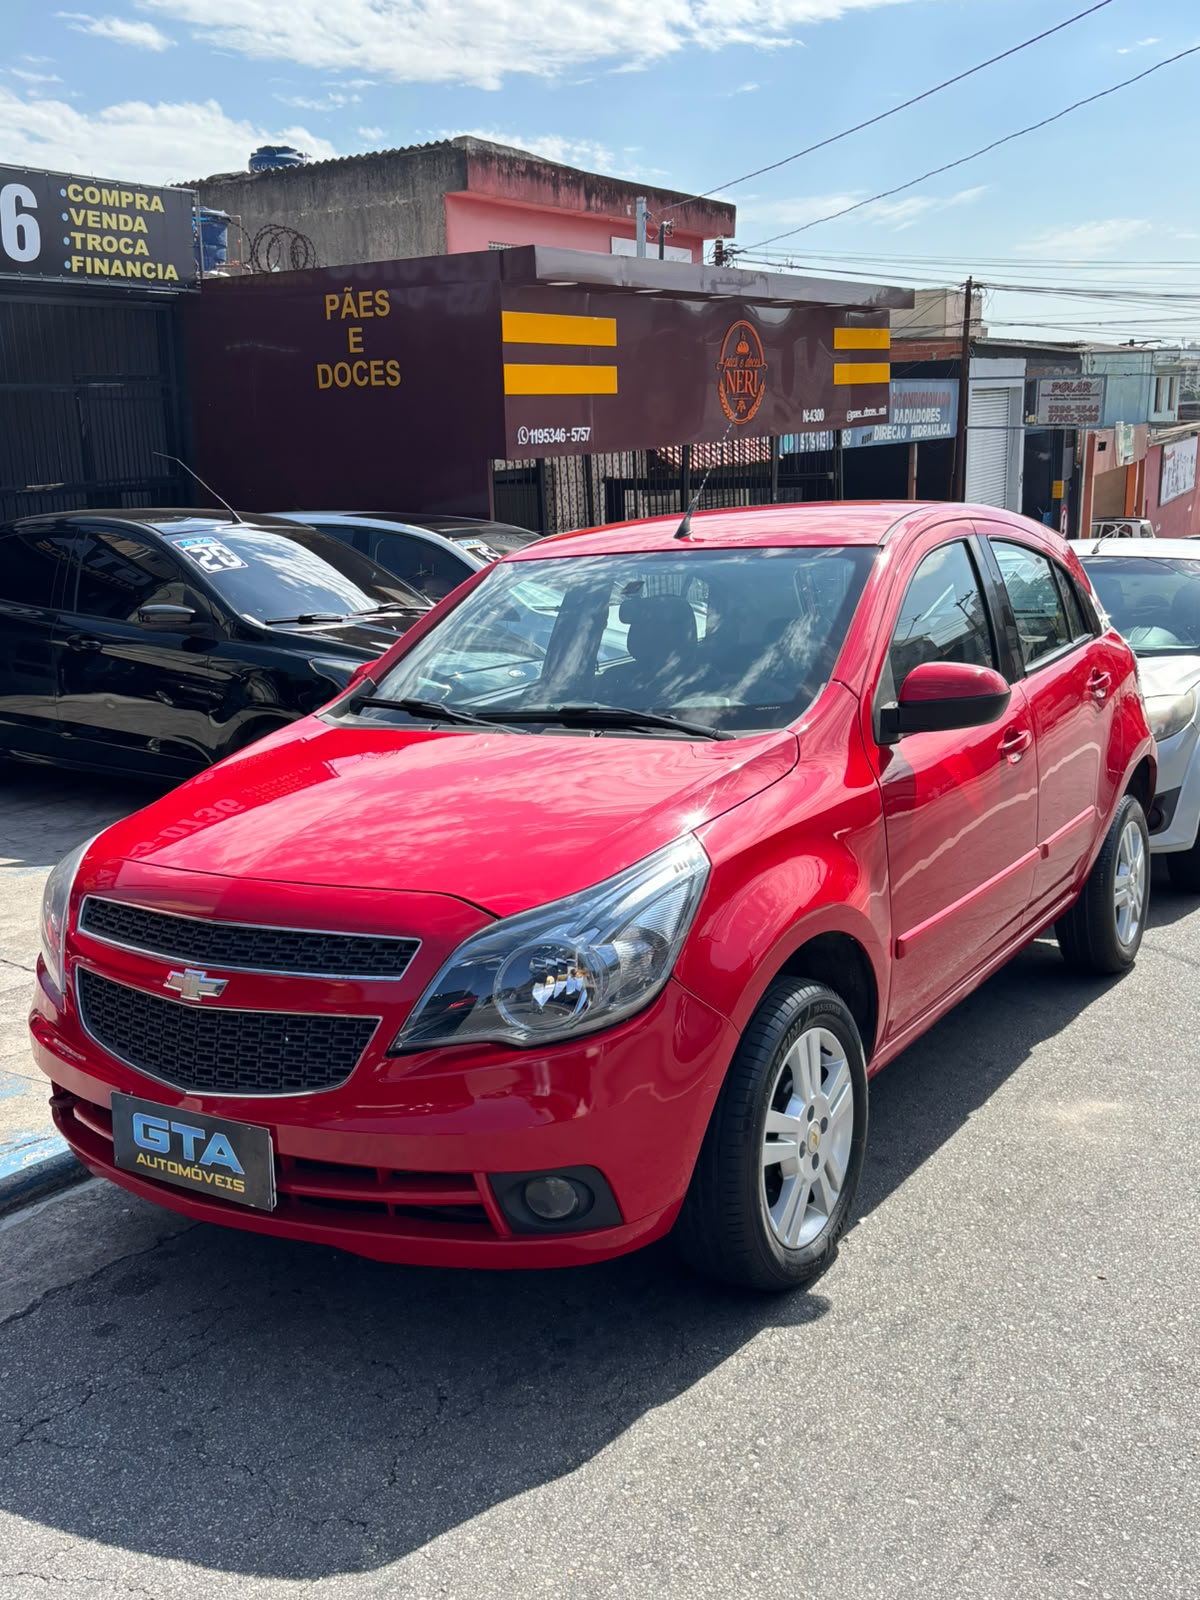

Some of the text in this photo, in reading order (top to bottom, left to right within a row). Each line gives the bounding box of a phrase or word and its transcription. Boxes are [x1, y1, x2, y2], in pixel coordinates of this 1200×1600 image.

[67, 184, 165, 212] COMPRA
[0, 183, 41, 262] 6
[69, 208, 149, 233] VENDA
[70, 232, 150, 256] TROCA
[71, 256, 179, 281] FINANCIA
[325, 286, 390, 320] PÃES
[348, 327, 364, 353] E
[317, 360, 401, 389] DOCES
[725, 369, 758, 397] NERI
[894, 408, 941, 424] RADIADORES
[529, 427, 591, 444] 1195346-5757
[132, 1112, 245, 1175] GTA
[136, 1152, 245, 1193] AUTOMÓVEIS
